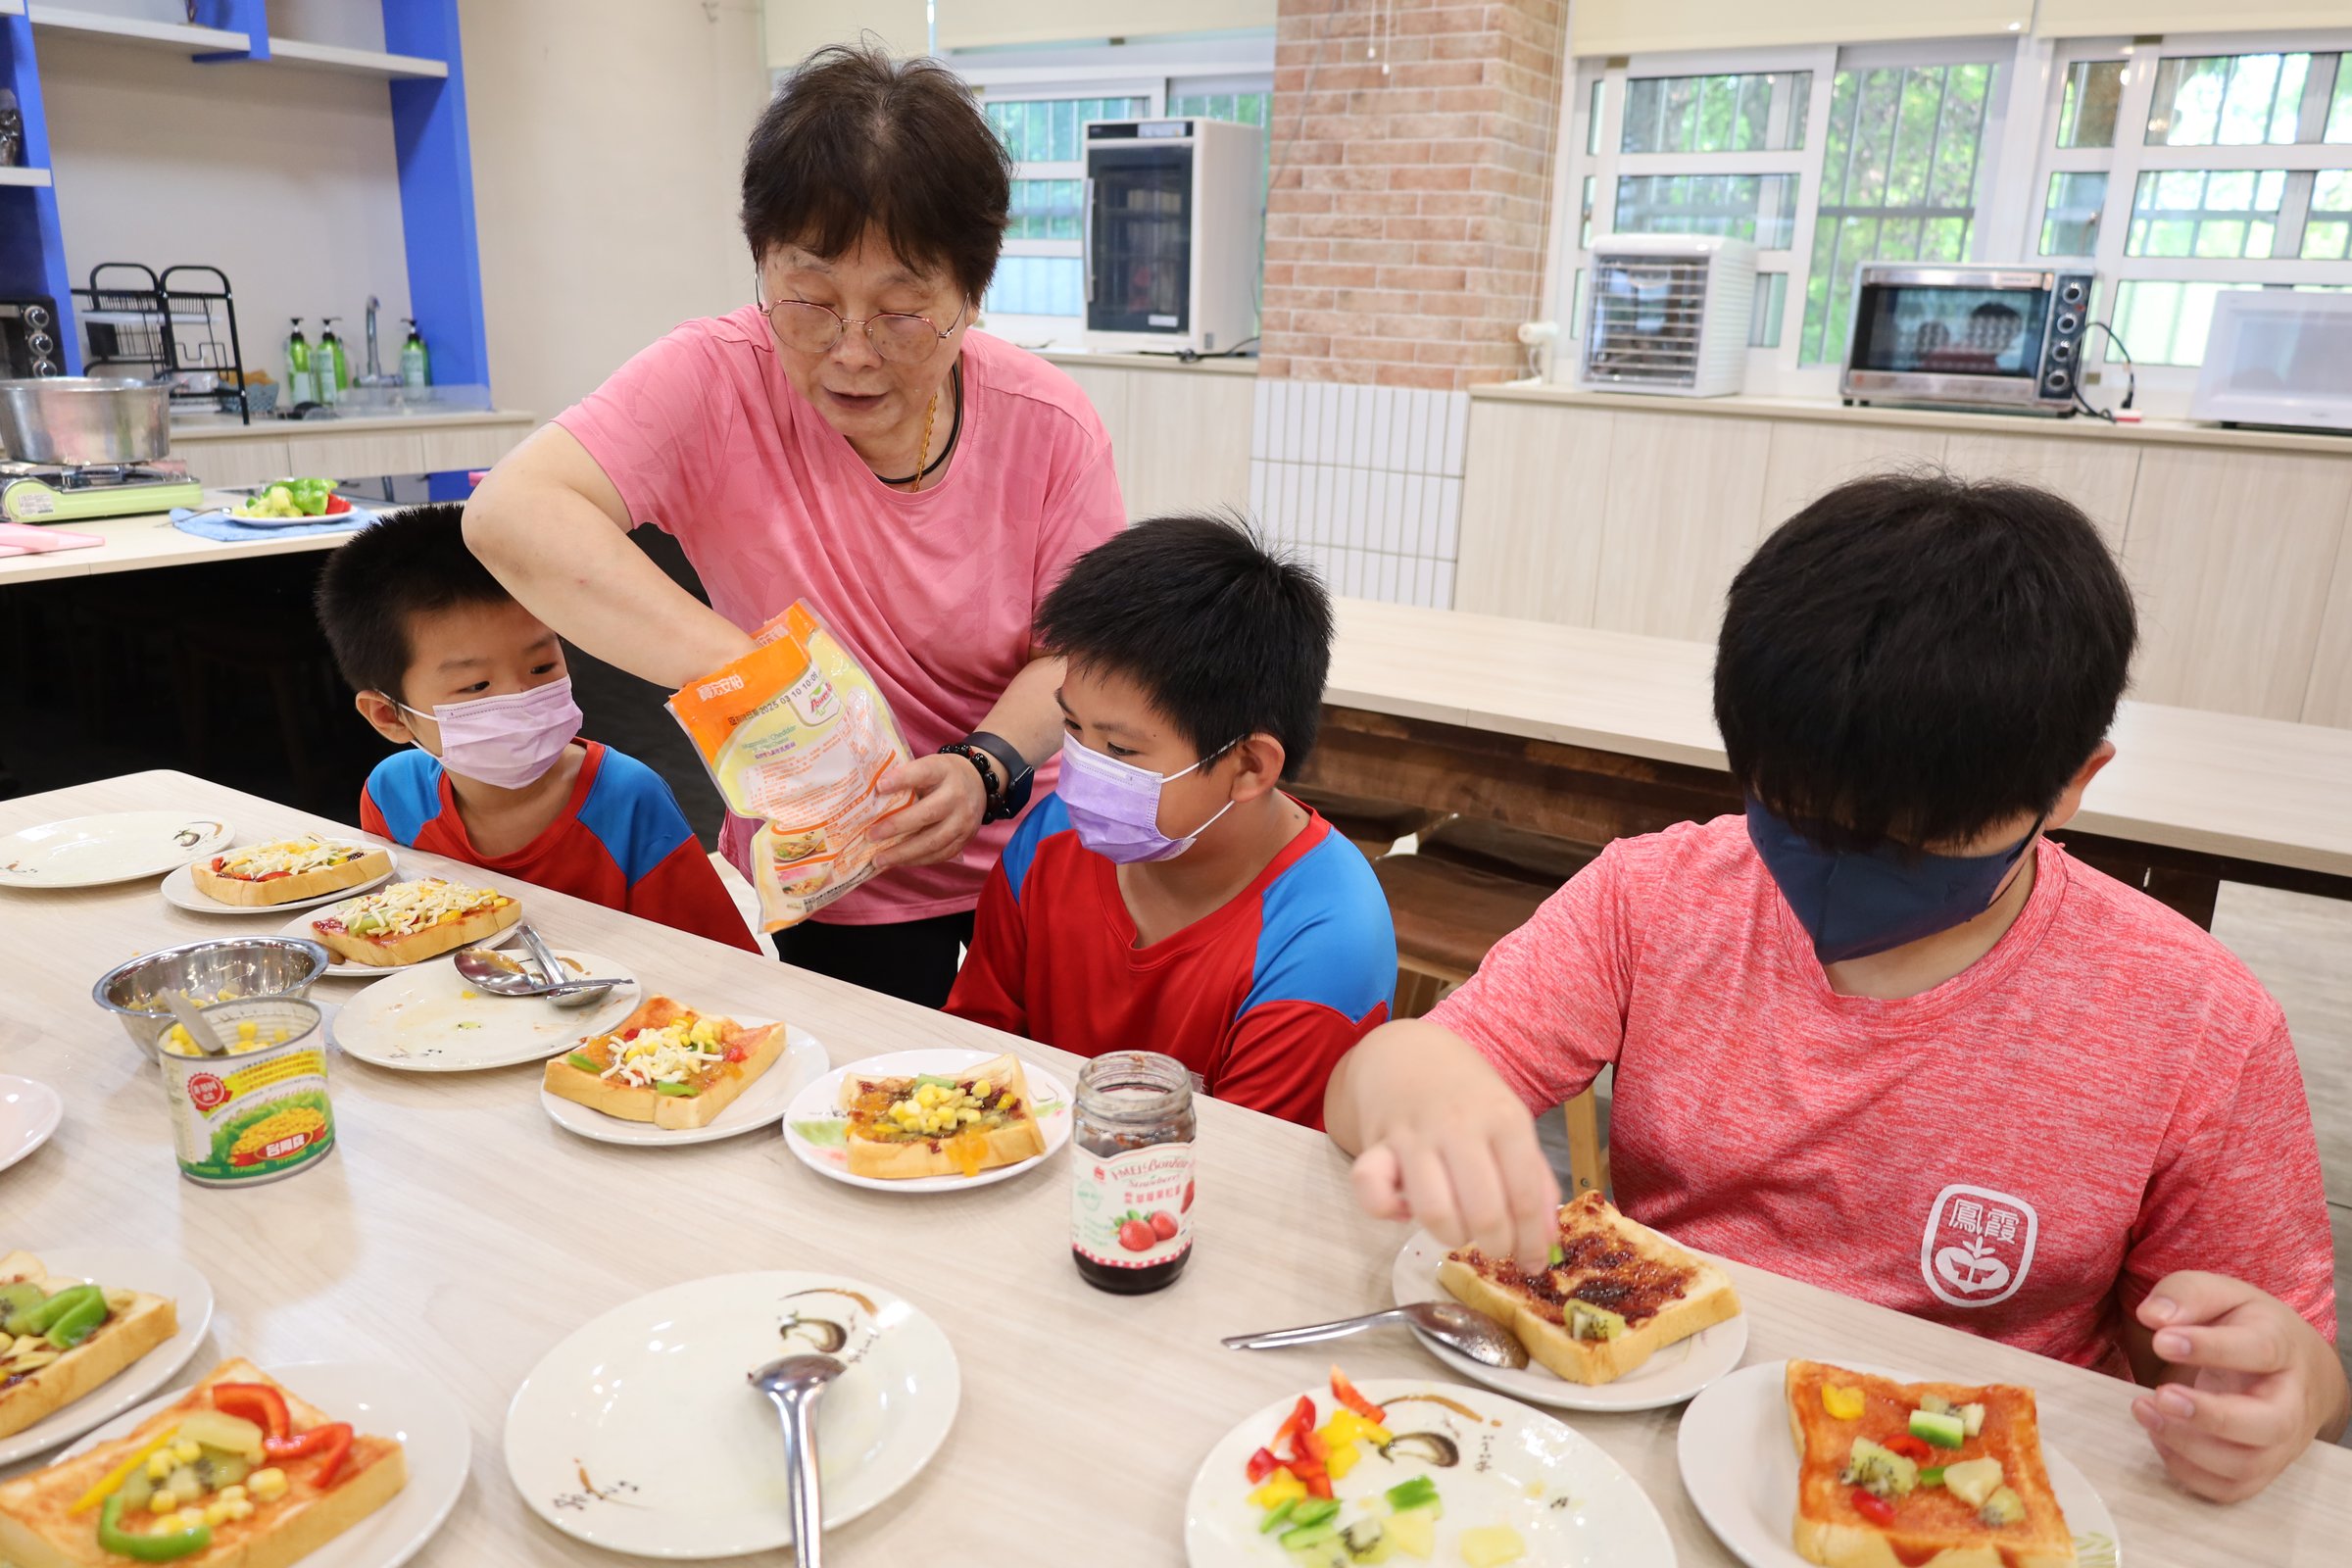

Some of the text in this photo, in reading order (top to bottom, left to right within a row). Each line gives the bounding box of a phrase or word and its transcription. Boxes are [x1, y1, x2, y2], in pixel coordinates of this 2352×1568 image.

[760, 701, 780, 716] 2025
[780, 694, 792, 706] 03
[792, 688, 803, 699] 10
[1948, 1199, 2020, 1245] 鳳霞
